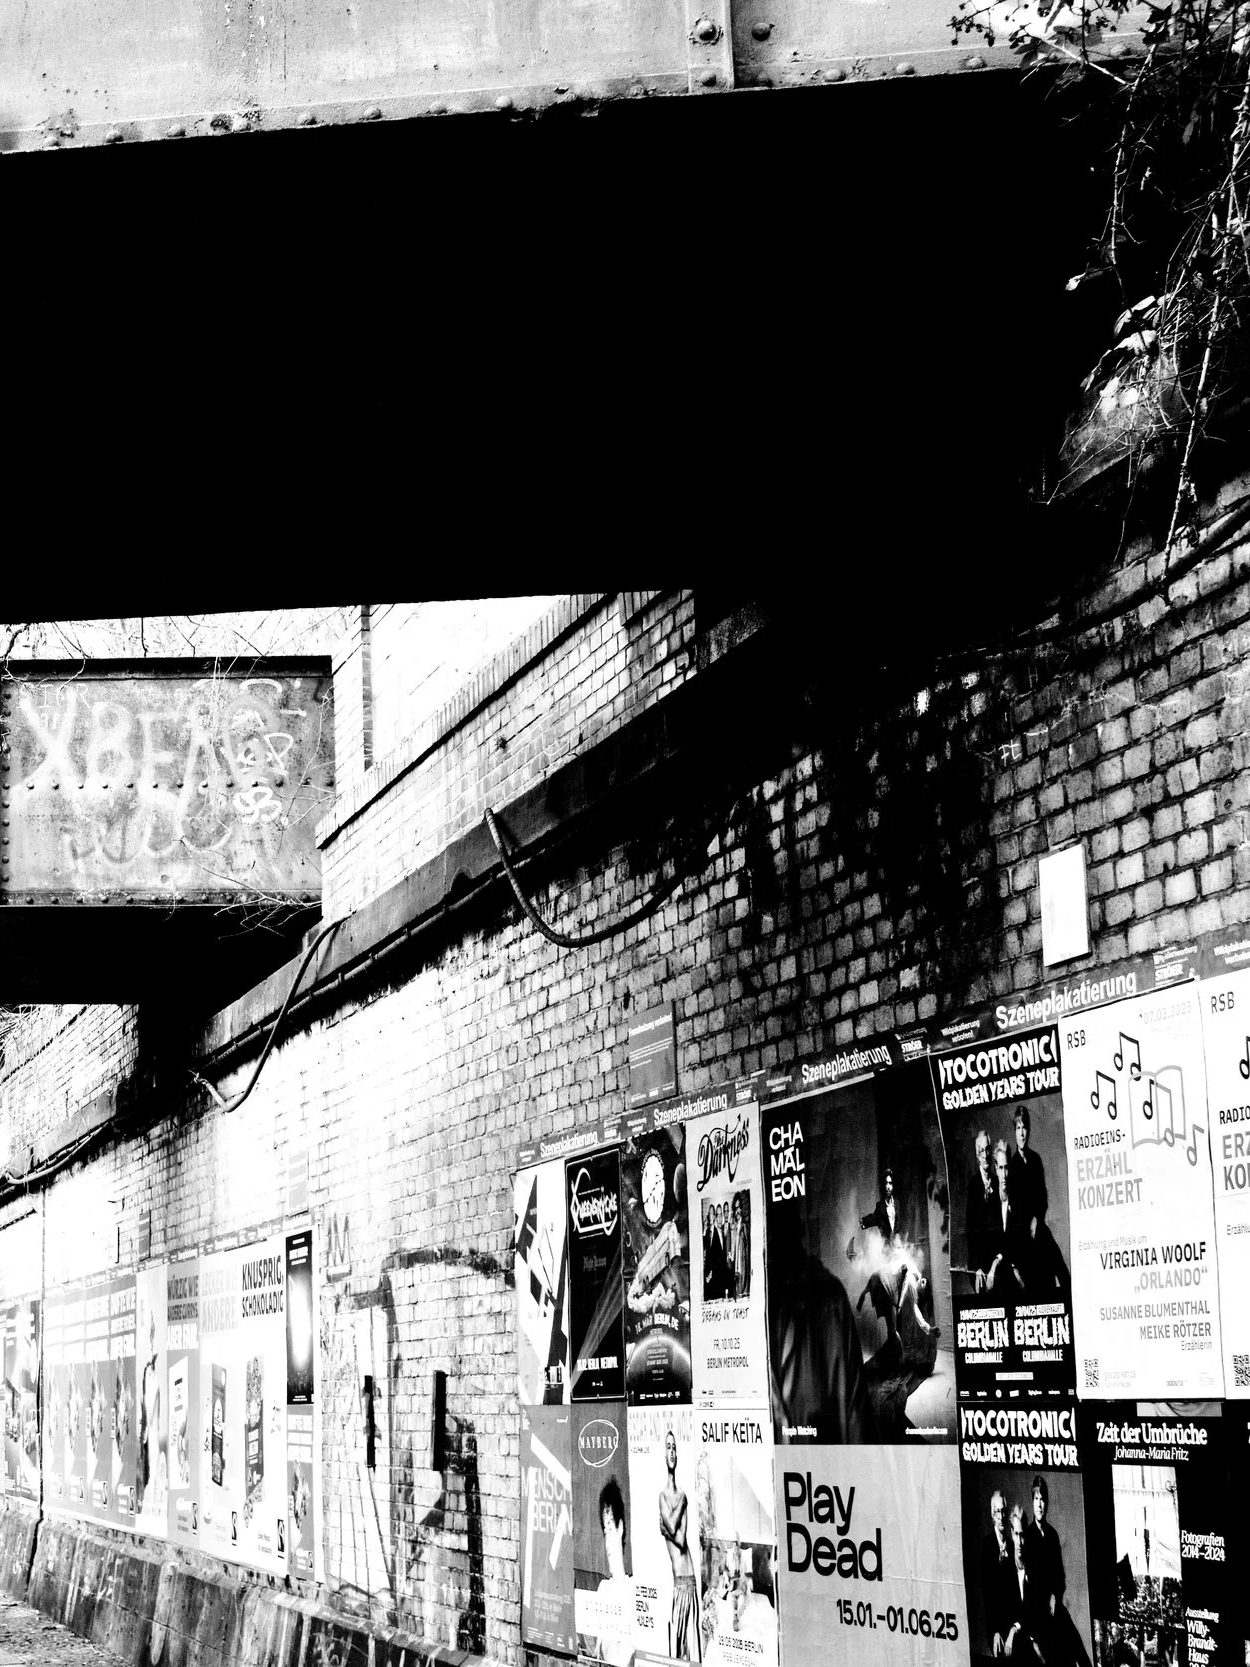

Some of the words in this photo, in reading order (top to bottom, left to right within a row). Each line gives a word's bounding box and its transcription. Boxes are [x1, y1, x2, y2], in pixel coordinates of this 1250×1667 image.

[996, 972, 1137, 1029] Szeneplakatierung
[1211, 991, 1235, 1014] RSB
[1067, 1029, 1086, 1049] RSB
[802, 1045, 892, 1084] Szeneplakatierung
[939, 1031, 1057, 1088] TOCOTRONIC
[942, 1075, 989, 1110] GOLDEN
[988, 1070, 1026, 1101] YEARS
[1025, 1066, 1060, 1091] TOUR
[654, 1093, 728, 1126] Szeneplakatierung
[540, 1130, 599, 1158] Szeneplakatierung
[769, 1121, 804, 1150] CHA
[1074, 1129, 1126, 1150] RADIOEINS-
[697, 1114, 750, 1192] Darkness
[770, 1146, 805, 1176] MÄL
[1076, 1148, 1133, 1182] ERZÄHL
[771, 1173, 806, 1202] EON
[1078, 1178, 1143, 1210] KONZERT
[1100, 1247, 1158, 1270] VIRGINIA
[1161, 1241, 1206, 1264] WOOLF
[242, 1255, 284, 1292] KNUSPRIG,
[242, 1290, 284, 1318] SCHOKOLADIG
[1100, 1305, 1143, 1321] SUSANNE
[1144, 1300, 1210, 1317] BLUMENTHAL
[958, 1318, 1009, 1351] BERLIN
[1014, 1314, 1070, 1348] BERLIN
[1140, 1324, 1171, 1340] MEIKE
[1173, 1320, 1211, 1338] RÖTZER
[1181, 1339, 1213, 1351] Erzählerin
[707, 1357, 723, 1369] BERLIN
[723, 1356, 750, 1368] METROPOL
[701, 1422, 729, 1443] SALIF
[732, 1416, 763, 1444] KEÏTA
[961, 1407, 1076, 1440] TOCOTRONIC
[1096, 1422, 1120, 1443] Zeit
[1120, 1423, 1142, 1444] der
[1142, 1425, 1208, 1446] Umbrüche
[963, 1441, 1007, 1463] GOLDEN
[1007, 1443, 1044, 1466] YEARS
[1044, 1443, 1079, 1467] TOUR
[1114, 1446, 1170, 1461] Johanna-Maria
[1171, 1447, 1190, 1461] Fritz
[783, 1471, 856, 1537] Play
[786, 1522, 884, 1582] Dead
[1181, 1529, 1225, 1550] Fotografien
[1185, 1606, 1219, 1624] Ausstellung
[1186, 1619, 1210, 1638] Willy-
[1187, 1633, 1218, 1651] Brandt-
[1188, 1647, 1210, 1665] Haus
